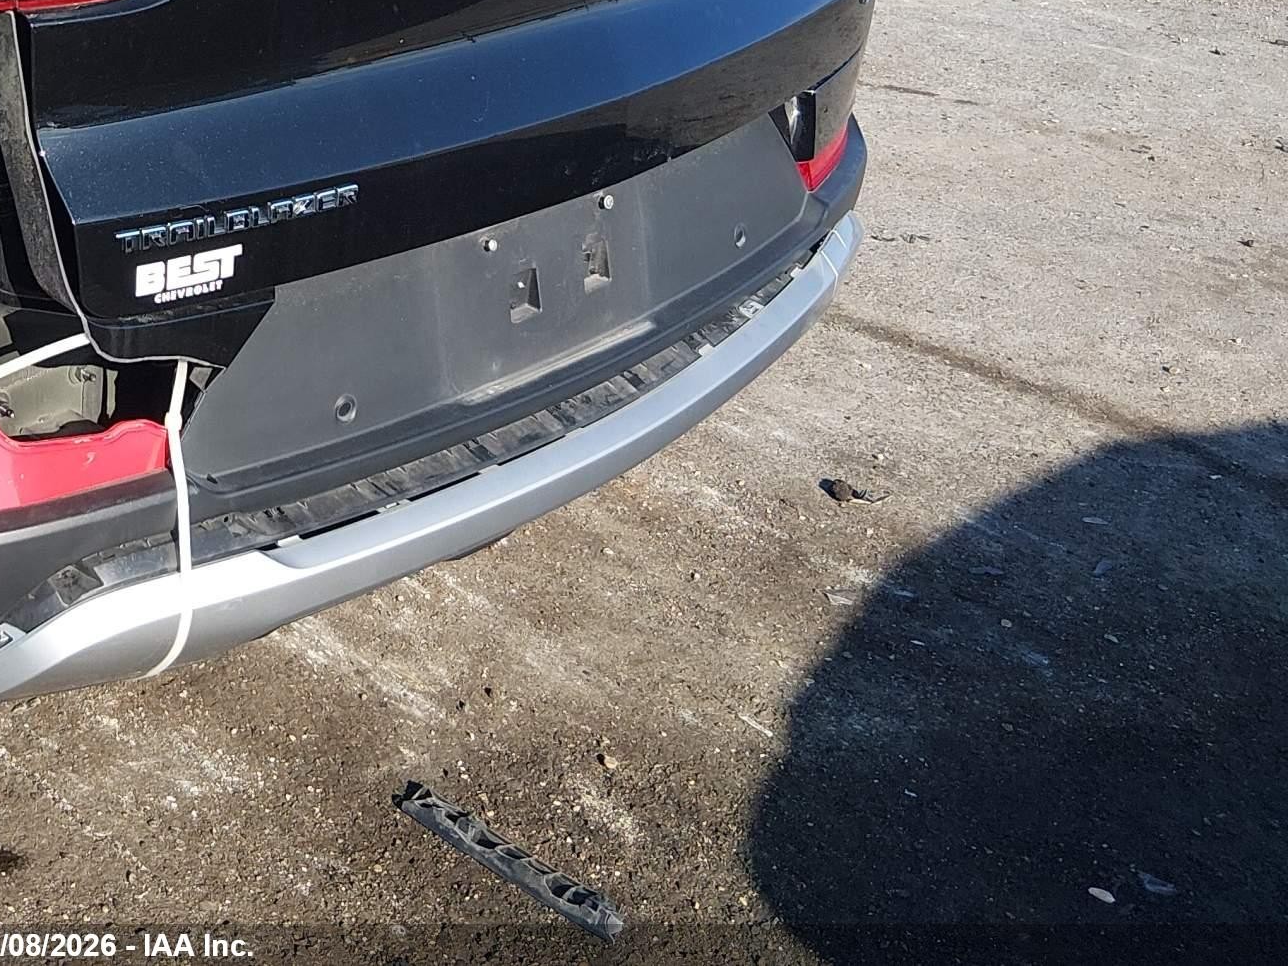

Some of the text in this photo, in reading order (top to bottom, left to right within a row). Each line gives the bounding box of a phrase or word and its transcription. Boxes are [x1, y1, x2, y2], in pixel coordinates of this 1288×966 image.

[115, 184, 359, 253] TRAILBLAZER
[135, 243, 243, 298] BEST
[154, 280, 223, 304] CHEVROLET
